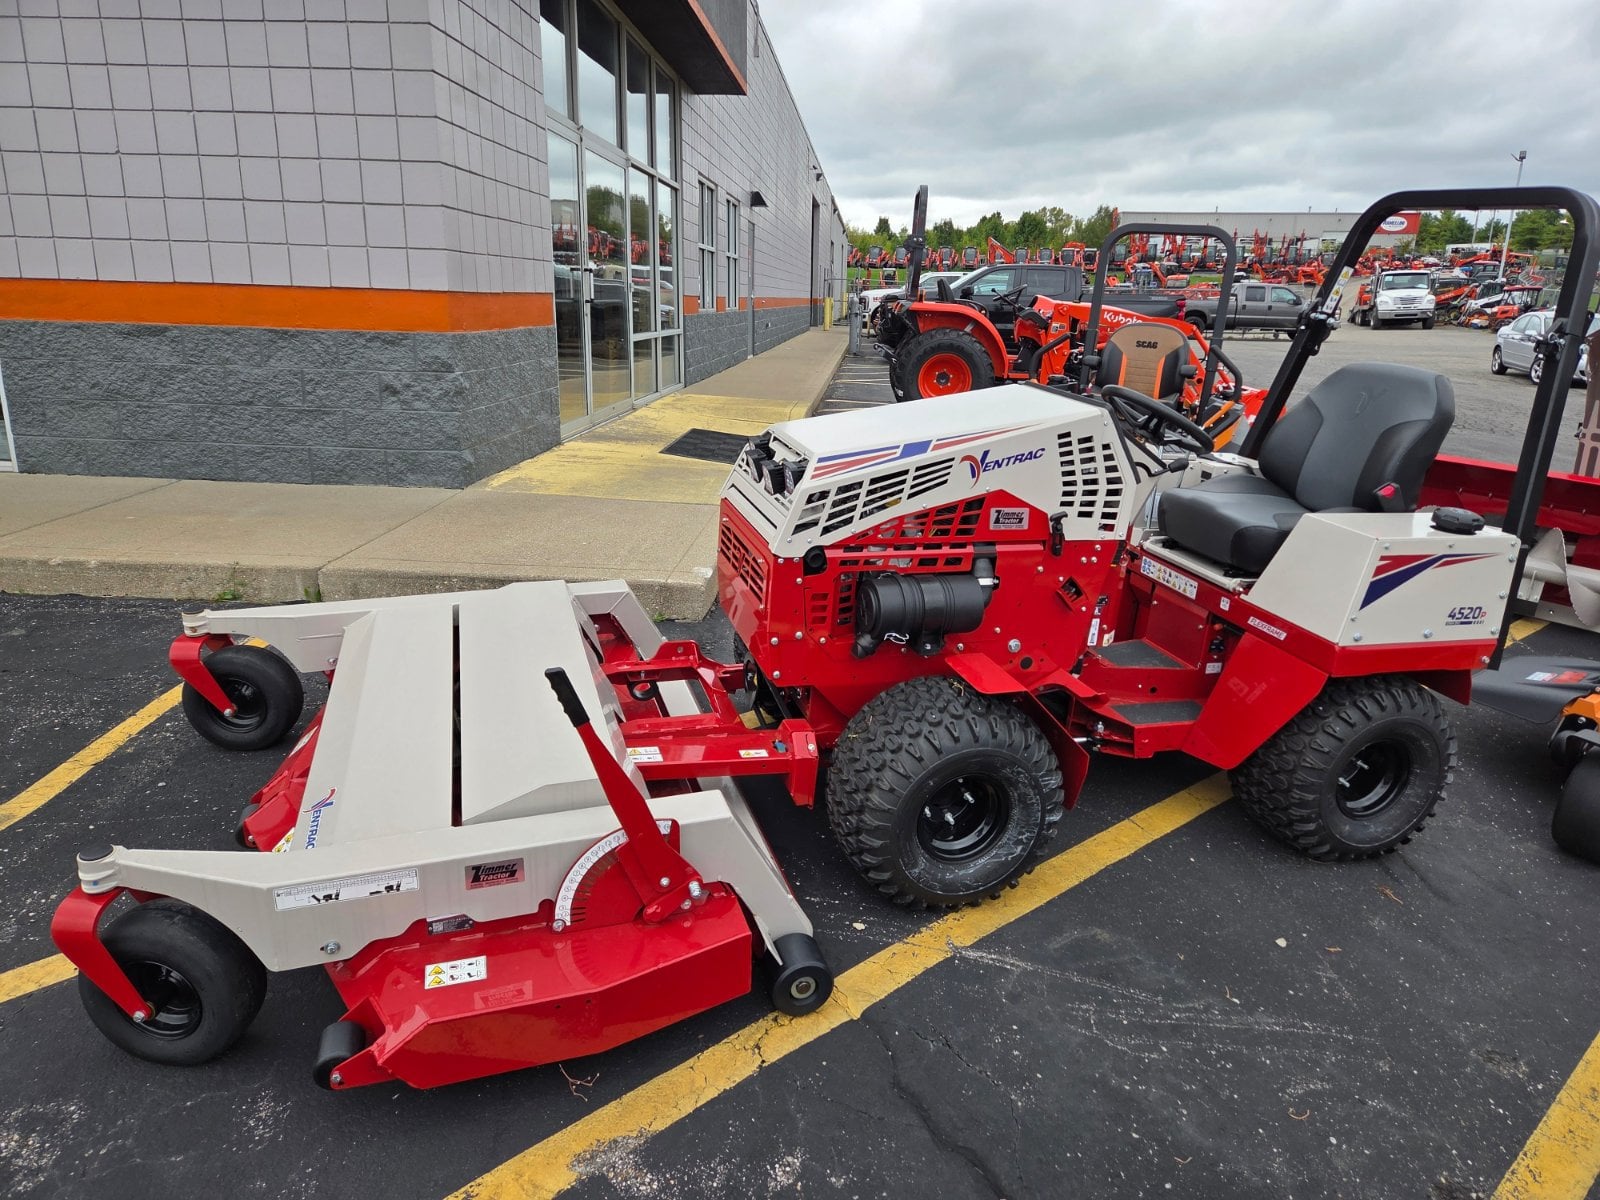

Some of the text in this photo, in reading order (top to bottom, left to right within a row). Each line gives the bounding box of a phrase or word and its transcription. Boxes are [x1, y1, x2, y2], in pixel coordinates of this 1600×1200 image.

[1136, 340, 1158, 349] SCAG
[959, 447, 1046, 489] VENTRAC
[993, 509, 1024, 524] Zimmer
[1250, 618, 1285, 638] FLEXFRAME
[302, 788, 336, 850] VENTRAC
[471, 863, 518, 883] Zimmer
[479, 872, 510, 881] Tractor
